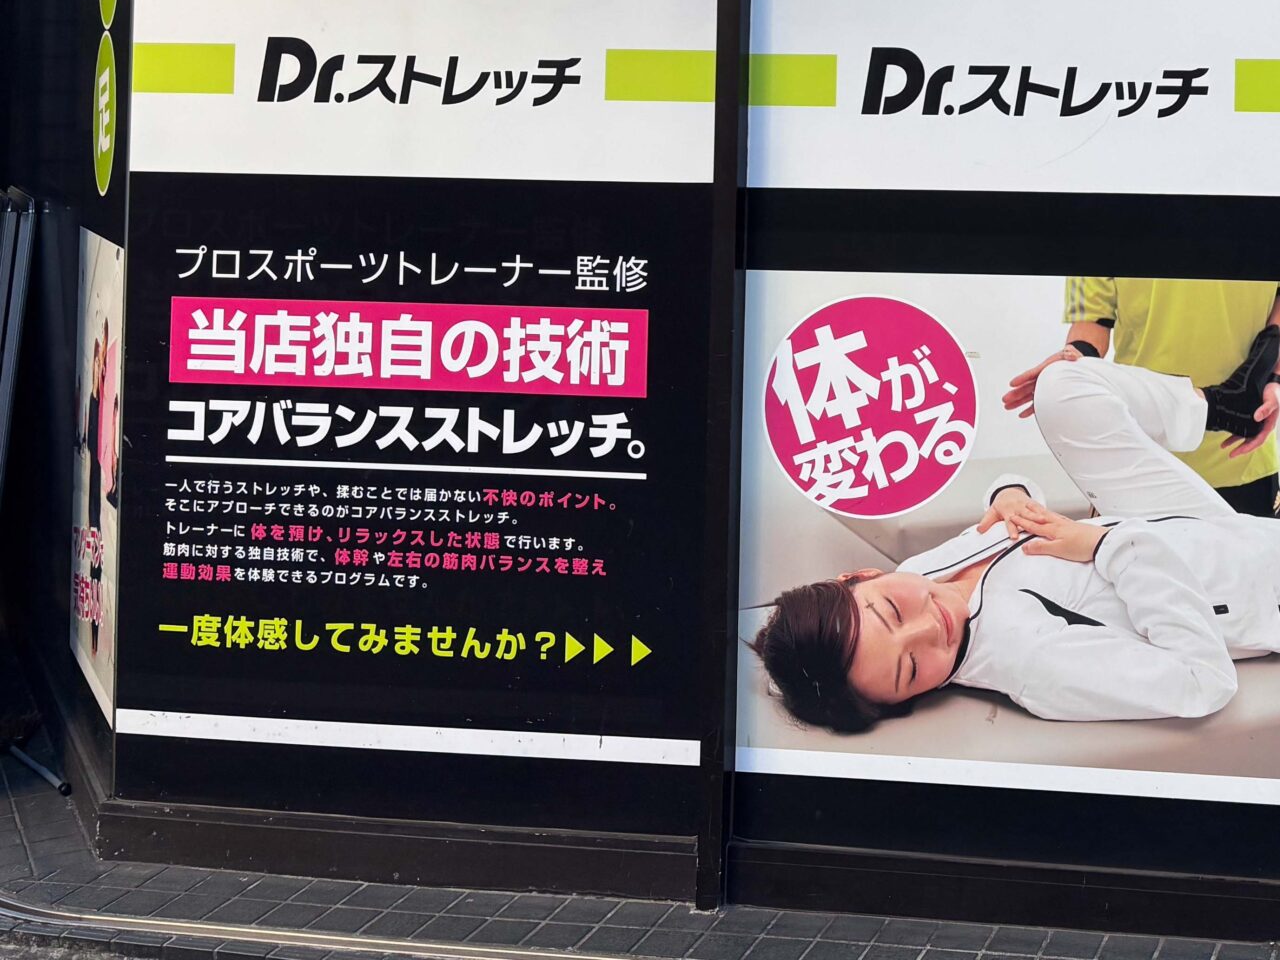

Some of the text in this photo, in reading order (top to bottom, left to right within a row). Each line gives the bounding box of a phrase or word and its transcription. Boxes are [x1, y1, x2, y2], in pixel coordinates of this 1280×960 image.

[257, 37, 582, 107] Dr.ストレッチ
[861, 47, 1209, 118] Dr.ストレッチ
[174, 245, 649, 293] プロスポーツトレーナー監修
[187, 308, 630, 386] 当店独自の技術
[167, 398, 646, 460] コアバランスストレッチ。
[793, 401, 974, 509] 変わる
